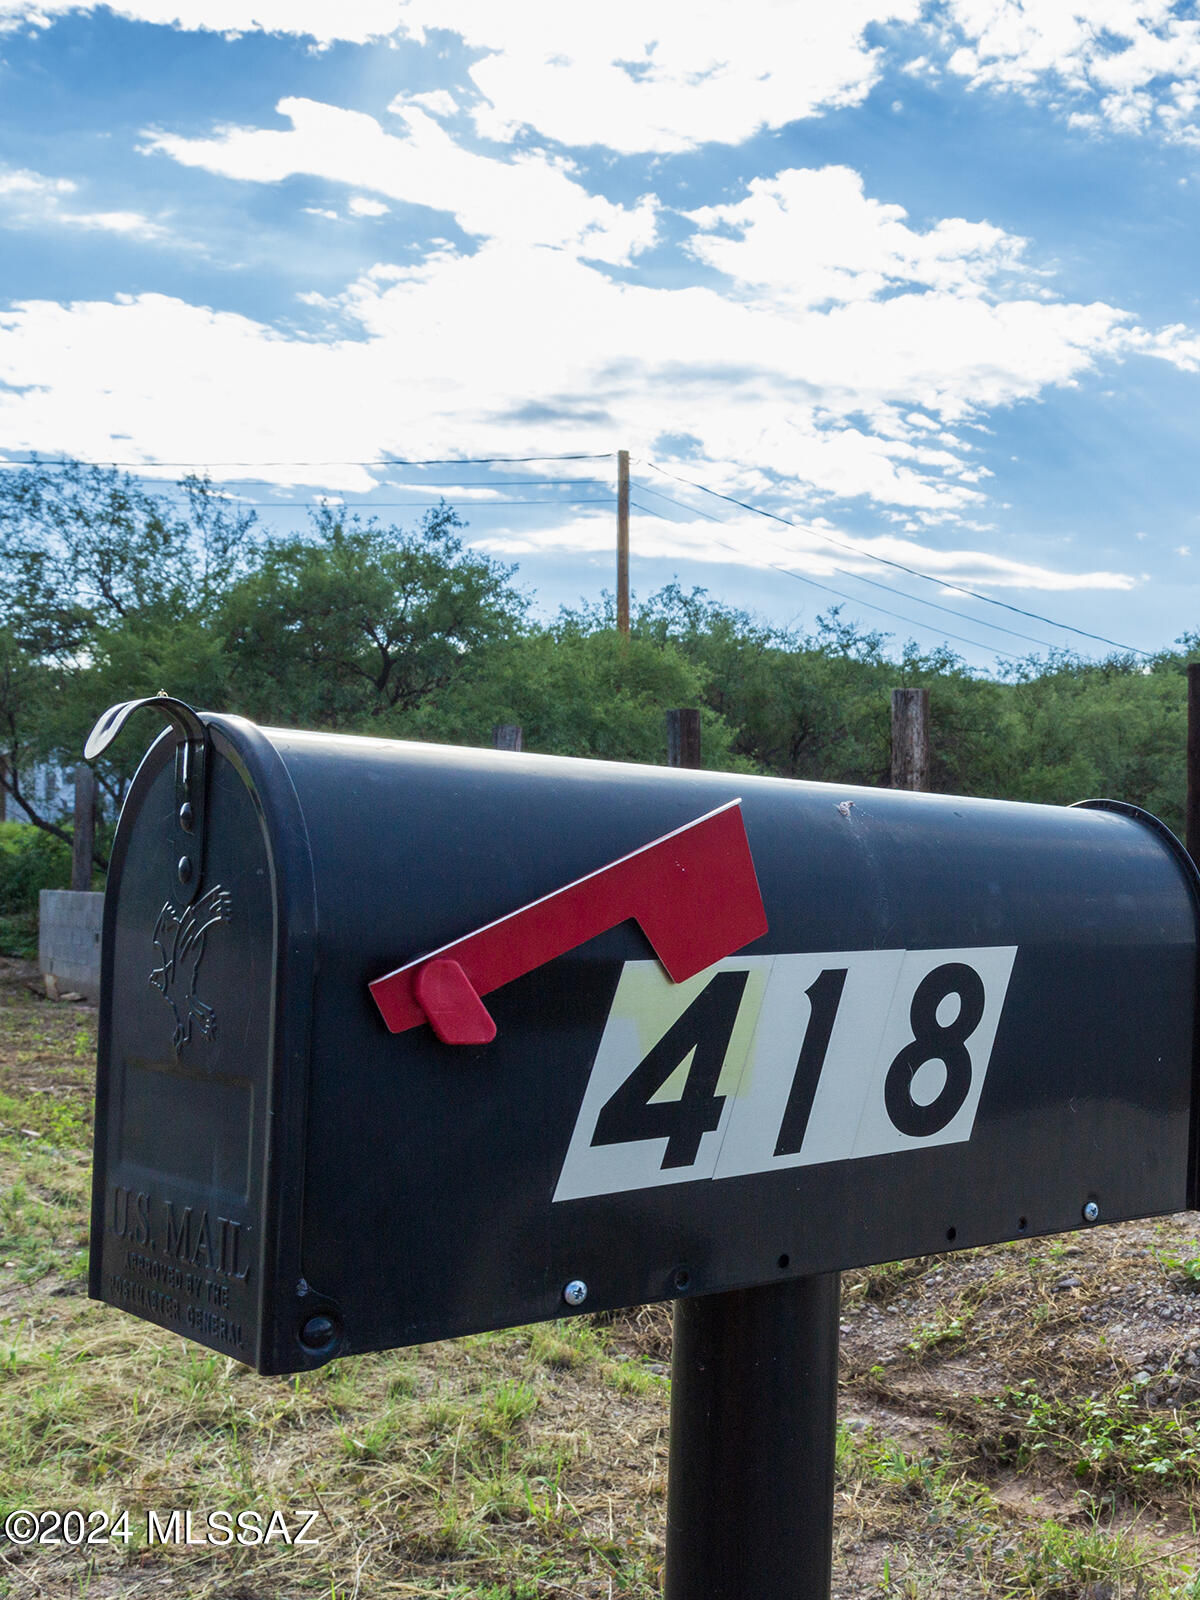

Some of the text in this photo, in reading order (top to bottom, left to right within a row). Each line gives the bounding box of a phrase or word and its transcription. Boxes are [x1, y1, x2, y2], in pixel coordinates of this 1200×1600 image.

[590, 962, 986, 1170] 418
[163, 1201, 250, 1279] MAIL
[126, 1252, 229, 1309] APPROVED BY THE
[187, 1305, 243, 1348] GENERAL
